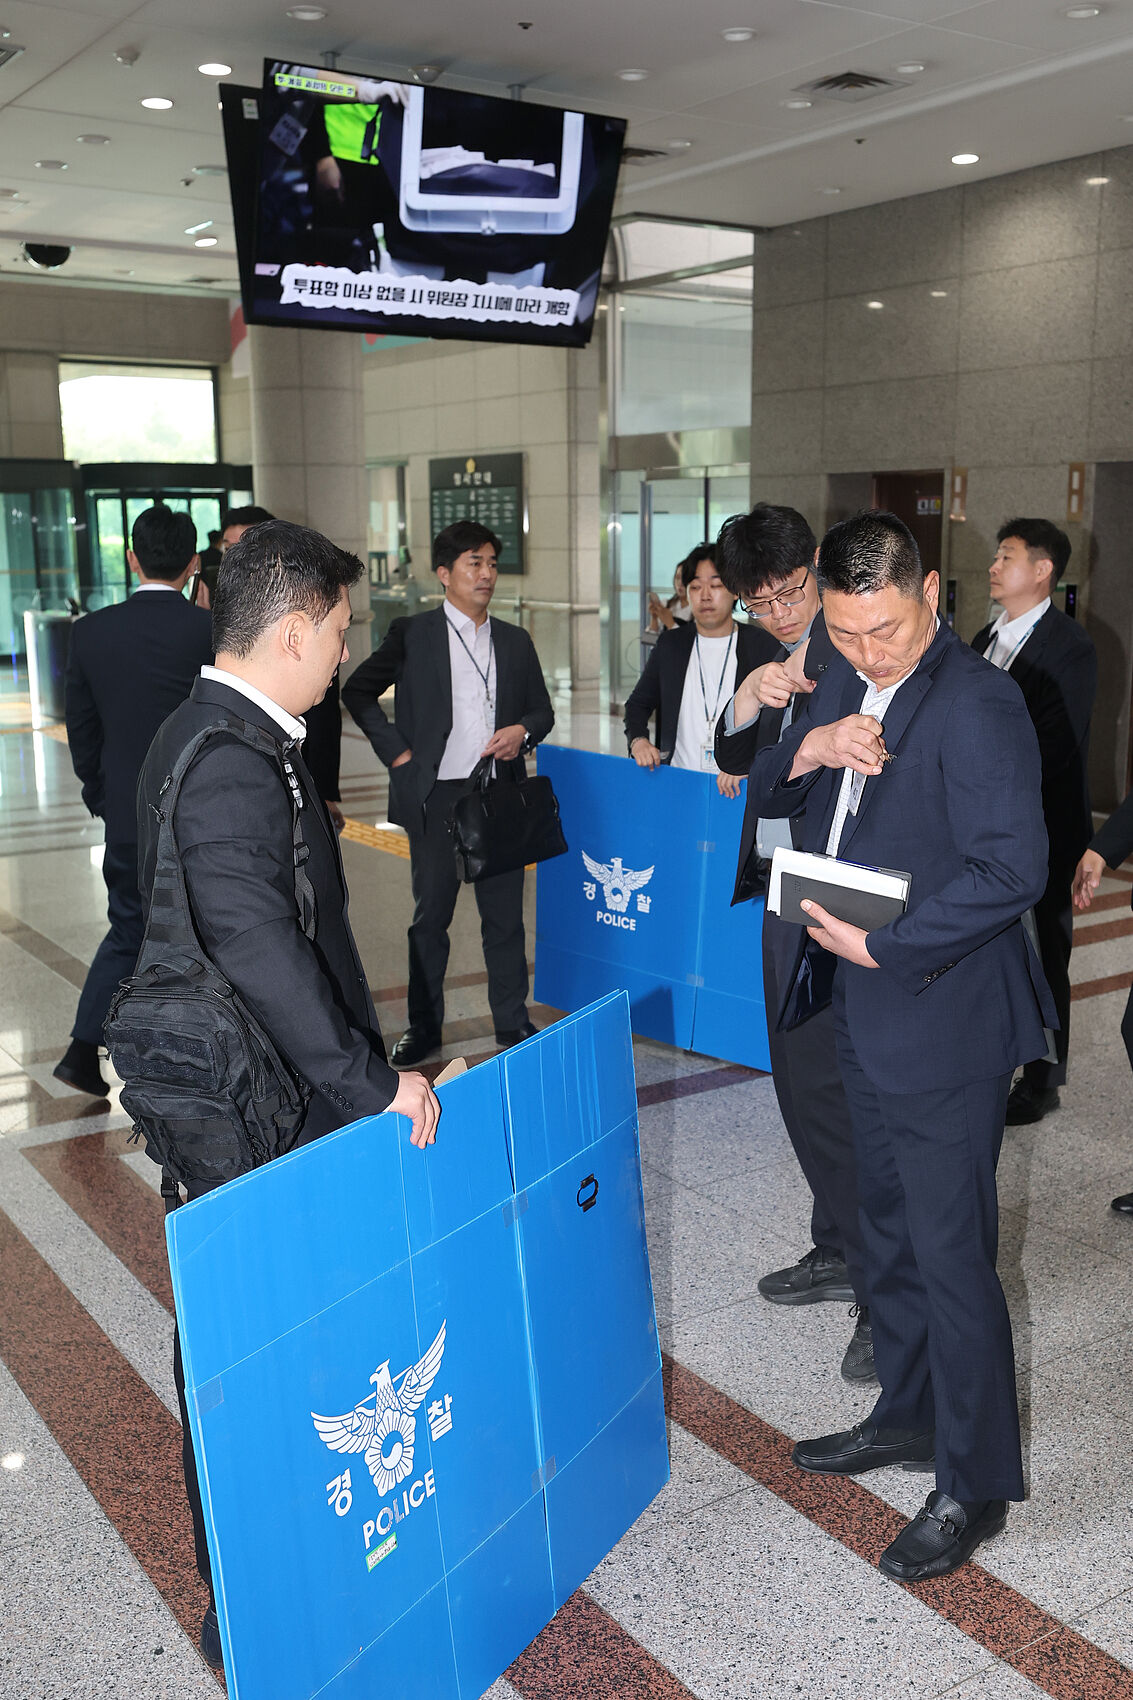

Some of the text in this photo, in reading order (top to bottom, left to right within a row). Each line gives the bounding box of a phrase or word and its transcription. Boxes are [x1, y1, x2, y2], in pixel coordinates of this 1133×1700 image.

[343, 283, 372, 299] 이상
[377, 285, 405, 302] 없을
[409, 289, 423, 304] 시
[427, 290, 468, 308] 위원장
[472, 294, 512, 311] 지시에
[515, 298, 541, 313] 따라
[596, 910, 636, 931] POLICE
[362, 1468, 436, 1550] POLICE
